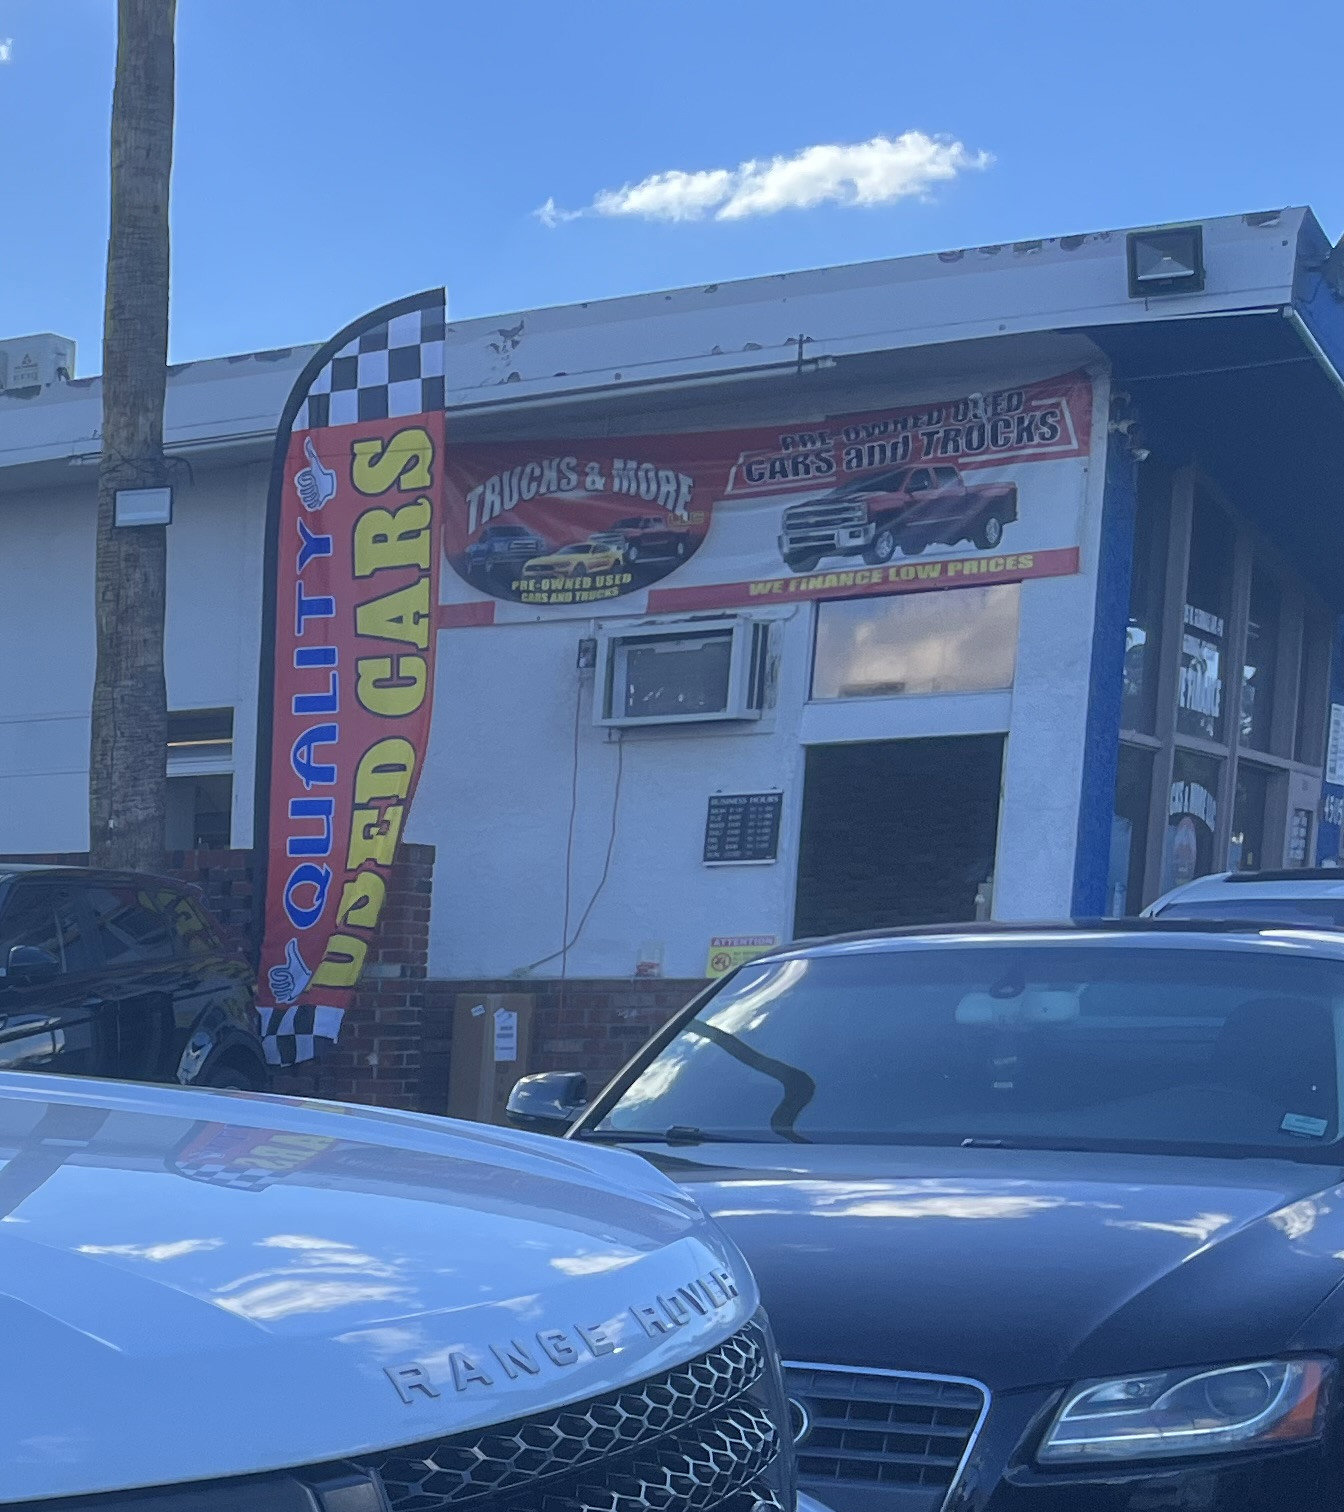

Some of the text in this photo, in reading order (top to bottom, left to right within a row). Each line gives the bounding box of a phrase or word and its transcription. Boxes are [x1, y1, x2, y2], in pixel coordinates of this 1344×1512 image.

[744, 410, 1061, 484] CARS and TRUCKS
[465, 456, 694, 535] TRUCKS & MORE
[595, 573, 632, 587] USED
[749, 554, 1034, 597] WE FINANCE LOW PRICES
[283, 516, 340, 930] QUALITY
[310, 427, 434, 988] USED CARS
[382, 1267, 740, 1404] RANGE ROVER
